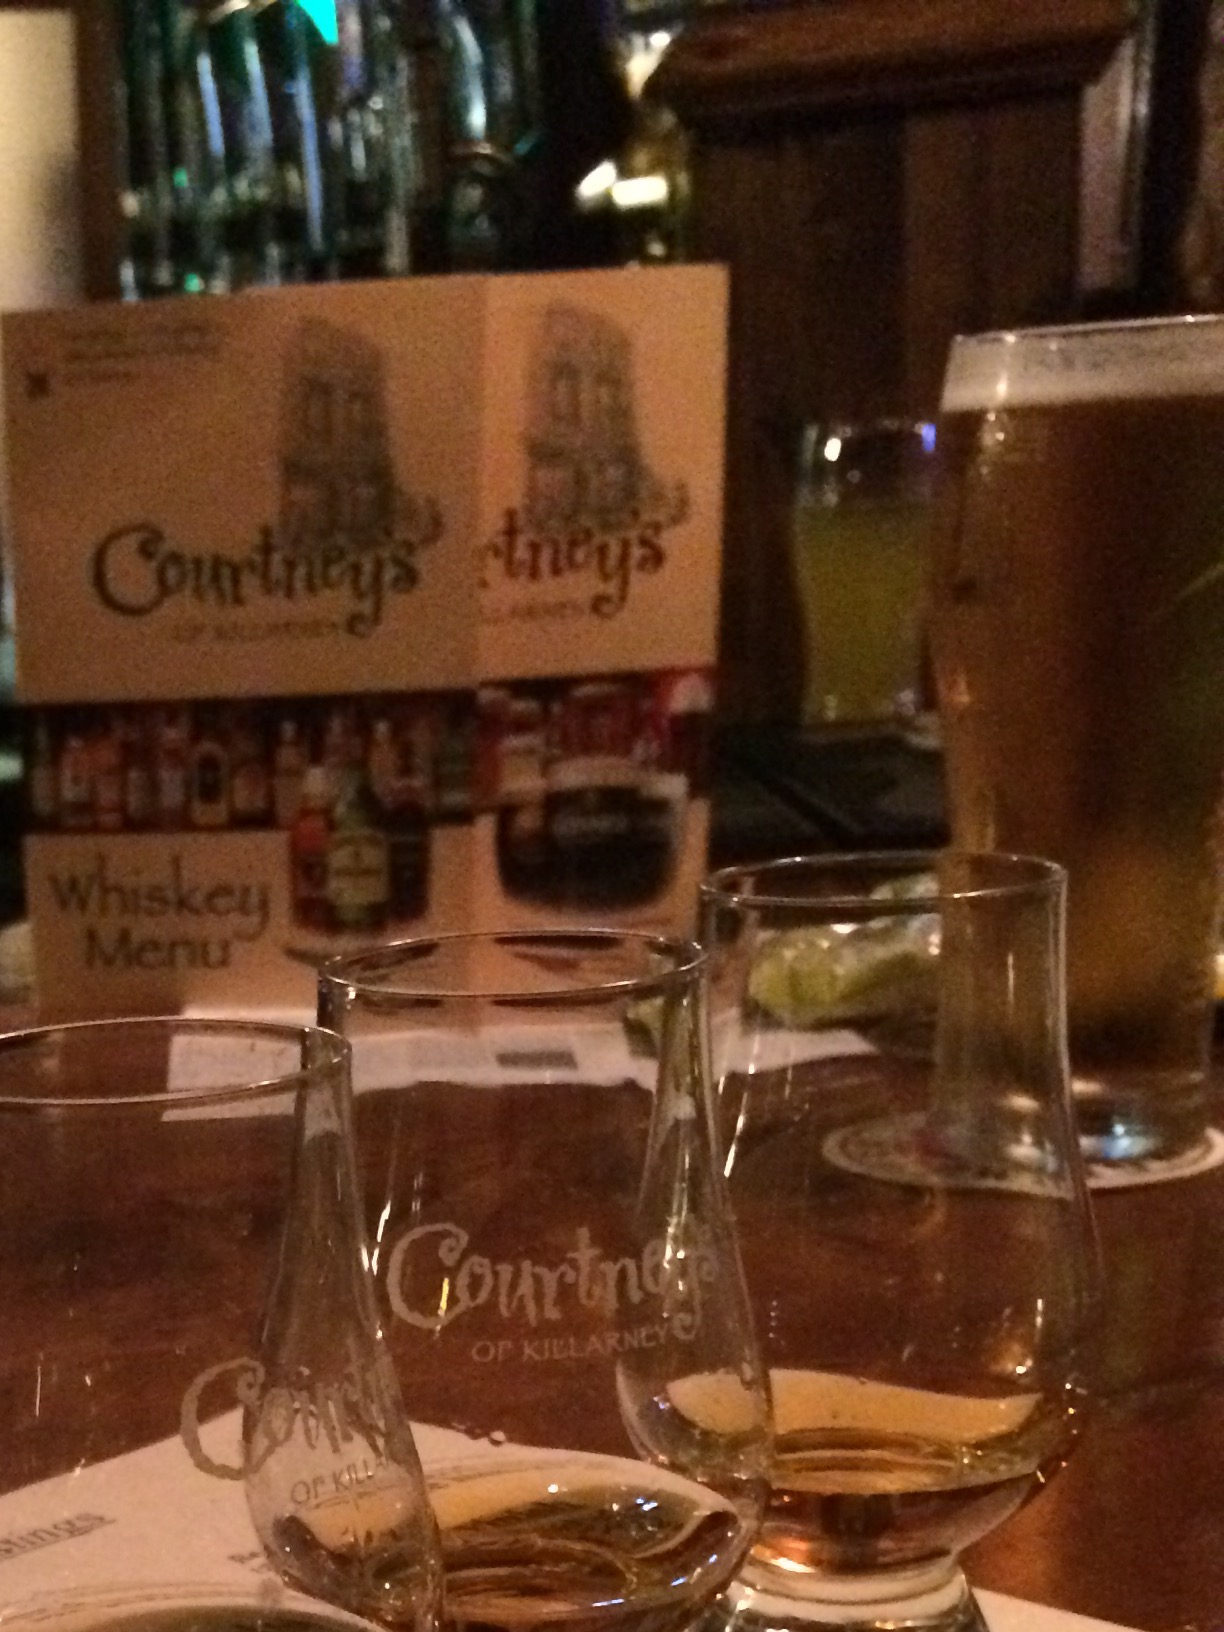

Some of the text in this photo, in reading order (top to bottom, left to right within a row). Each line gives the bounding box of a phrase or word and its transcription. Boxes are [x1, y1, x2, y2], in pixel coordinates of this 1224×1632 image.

[49, 852, 271, 942] Whiskey
[84, 928, 231, 969] Menu
[471, 1339, 514, 1363] OF
